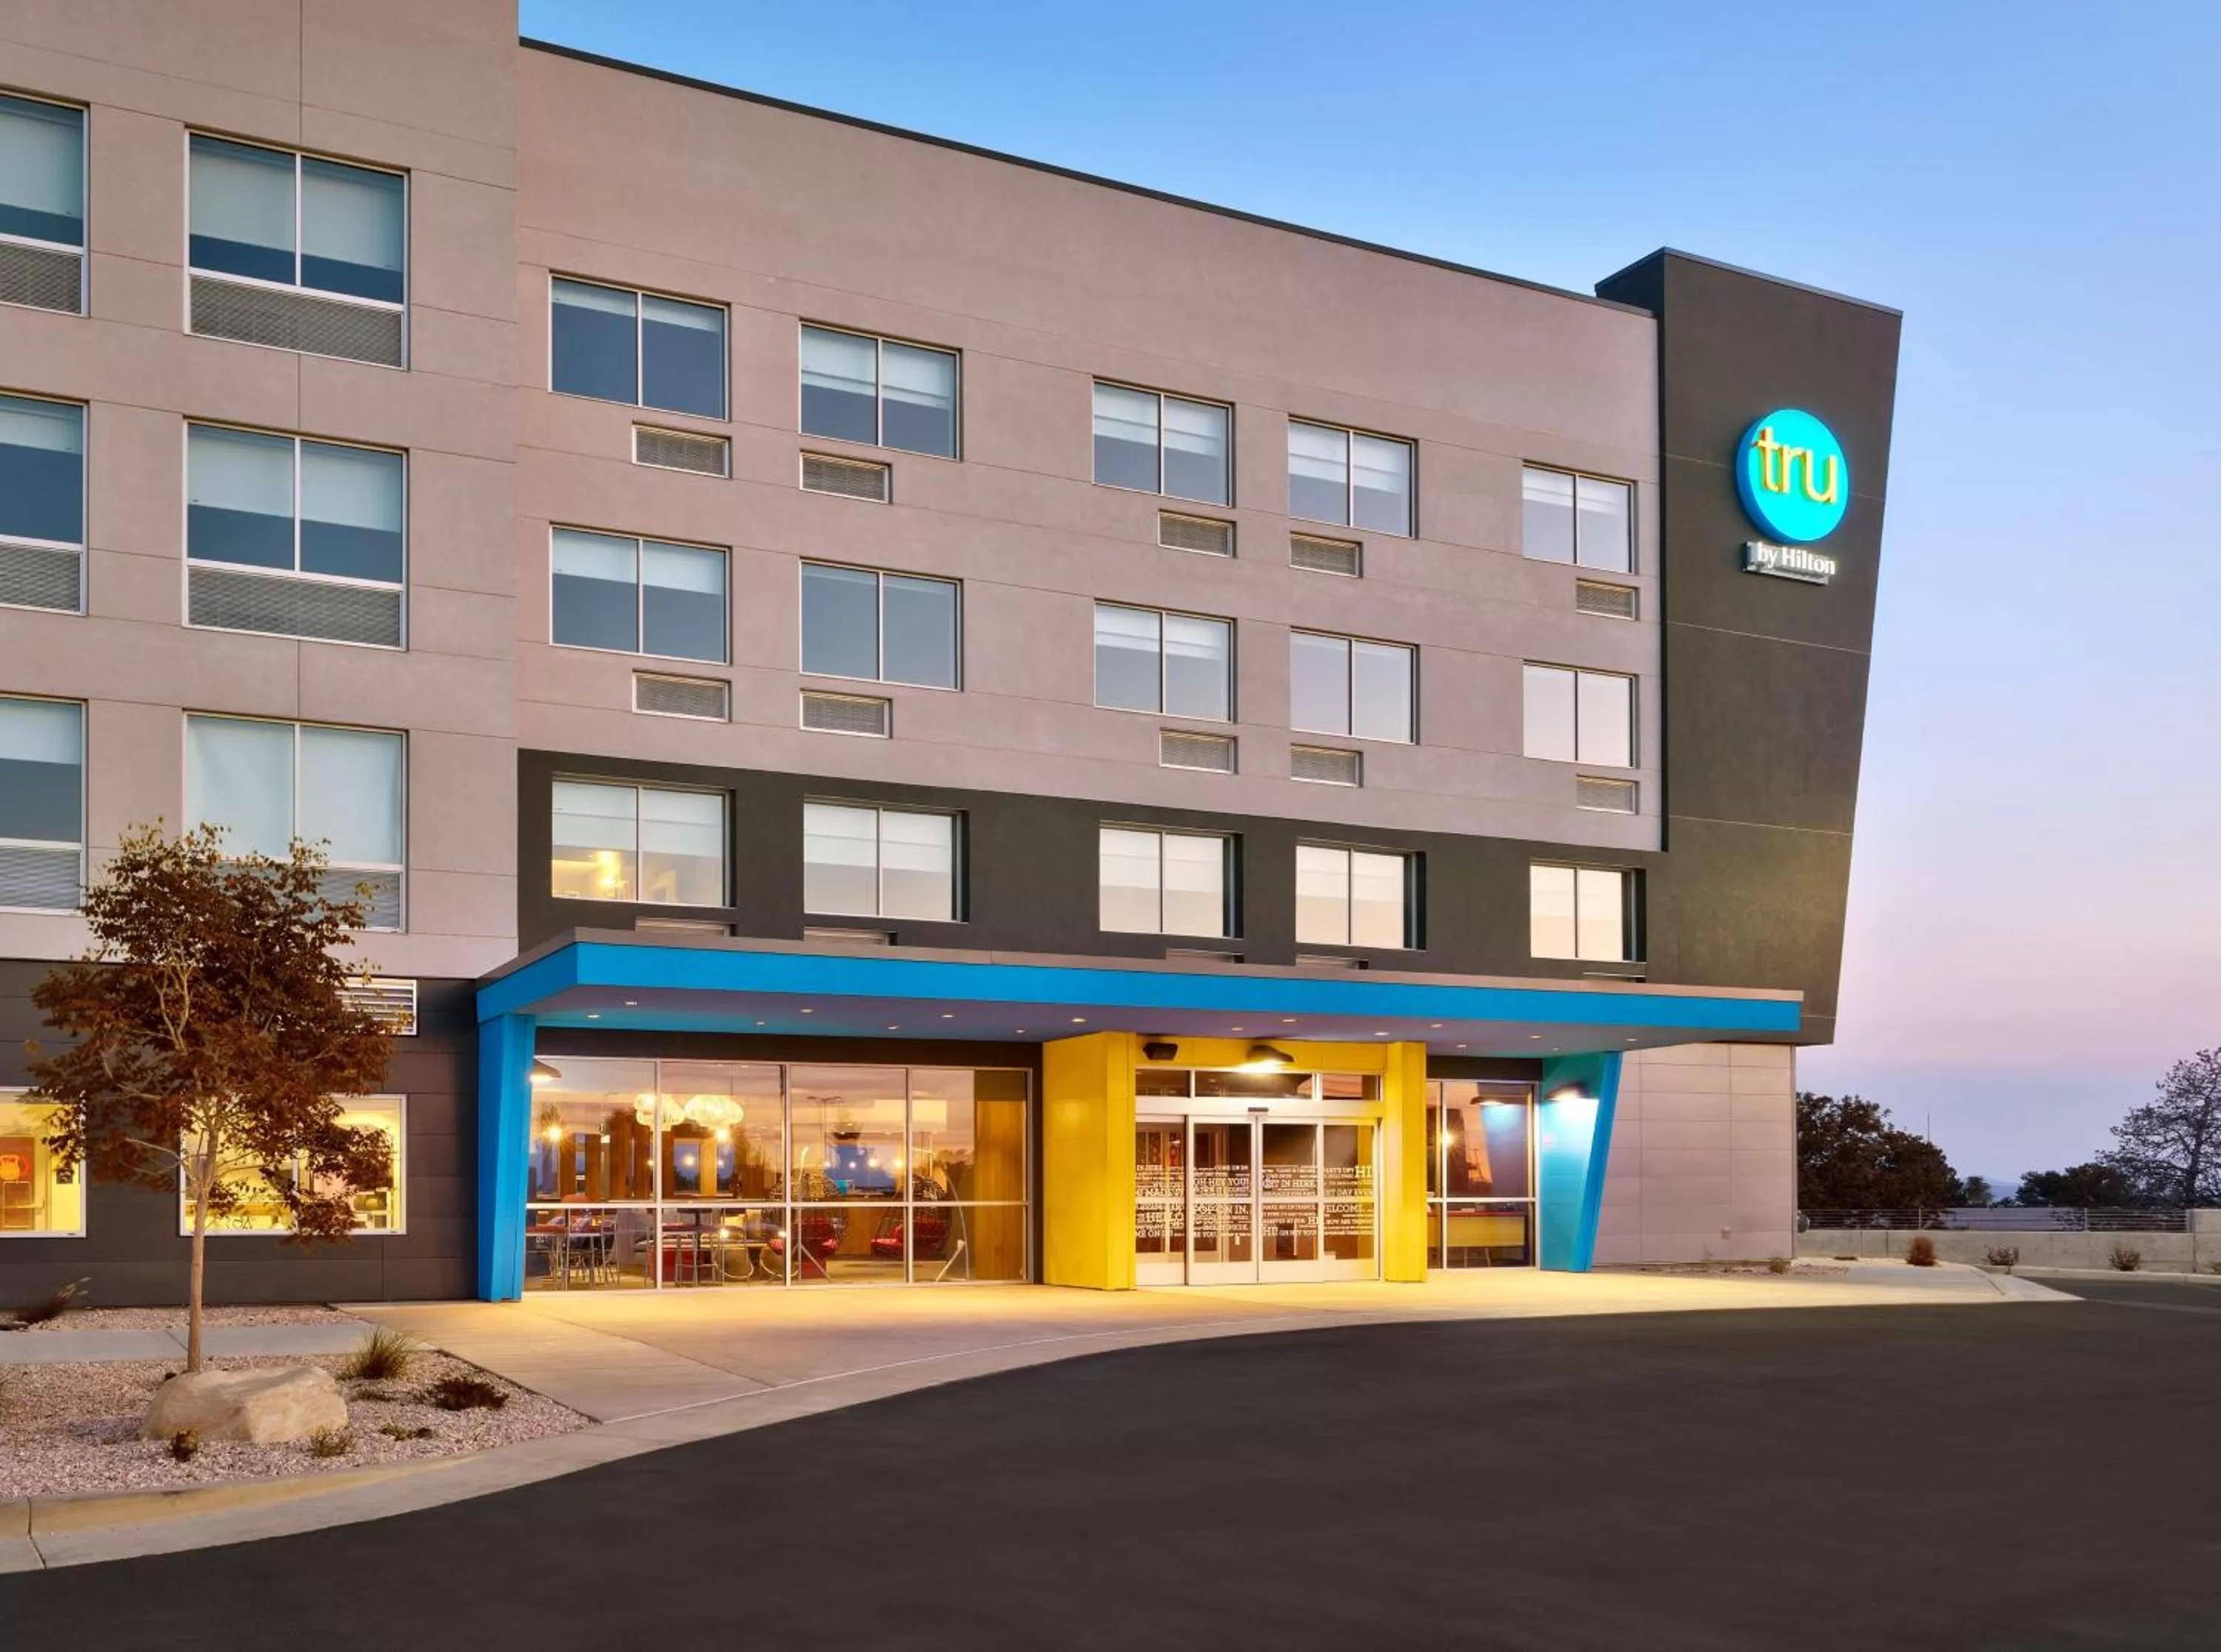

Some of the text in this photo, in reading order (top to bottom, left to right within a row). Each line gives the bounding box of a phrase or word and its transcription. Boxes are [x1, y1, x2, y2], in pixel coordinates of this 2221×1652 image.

[1752, 426, 1838, 503] tru
[1757, 542, 1836, 574] by Hilton
